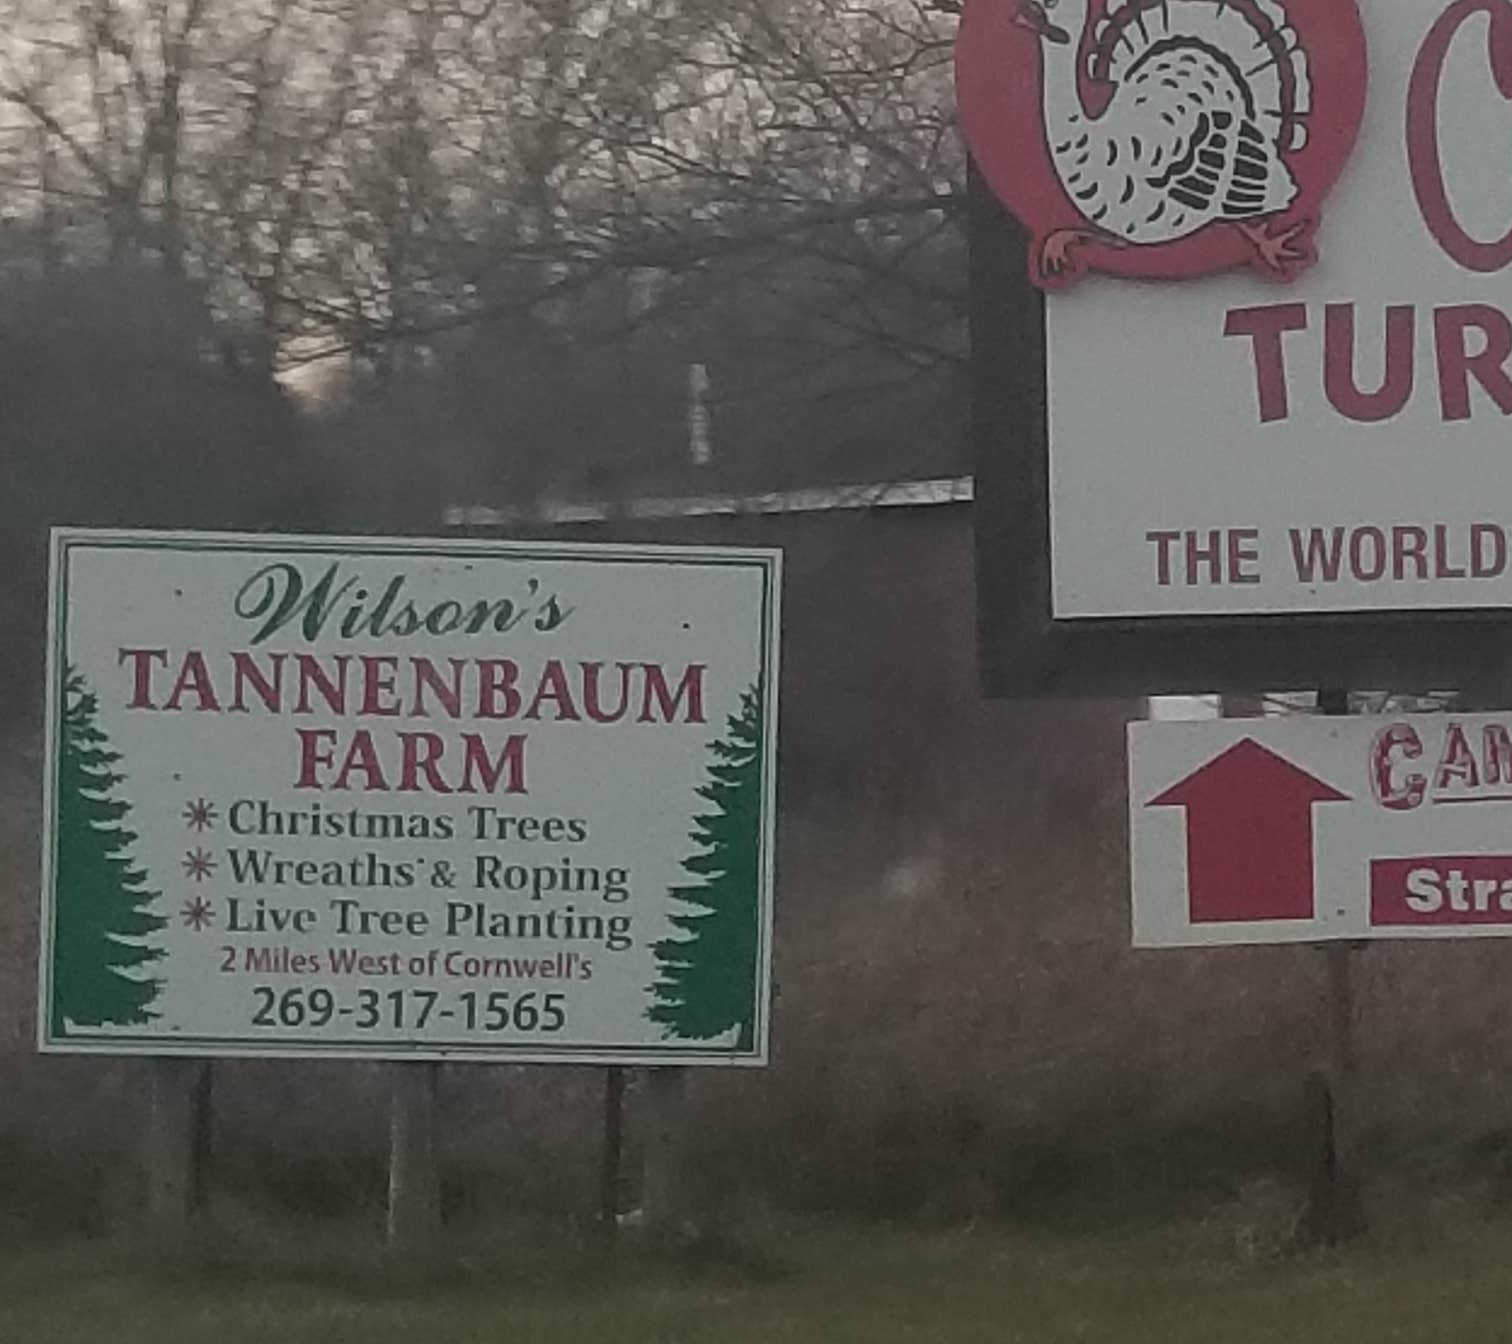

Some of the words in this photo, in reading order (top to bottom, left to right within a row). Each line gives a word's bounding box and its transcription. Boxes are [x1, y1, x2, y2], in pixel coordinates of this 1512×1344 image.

[1146, 529, 1260, 584] THE
[235, 562, 573, 645] Wilson's
[119, 649, 707, 724] TANNENBAUM
[294, 728, 528, 795] FARM
[228, 801, 453, 840] Christmas
[468, 808, 587, 842] Trees
[430, 861, 456, 889] &
[475, 856, 629, 902] Roping
[225, 899, 316, 935] Live
[330, 901, 428, 937] Tree
[445, 903, 632, 949] Planting
[220, 947, 236, 973] 2
[245, 948, 320, 975] Miles
[328, 950, 400, 976] West
[408, 951, 440, 977] of
[445, 951, 593, 980] Cornwell's
[252, 987, 566, 1031] 269-317-1565
